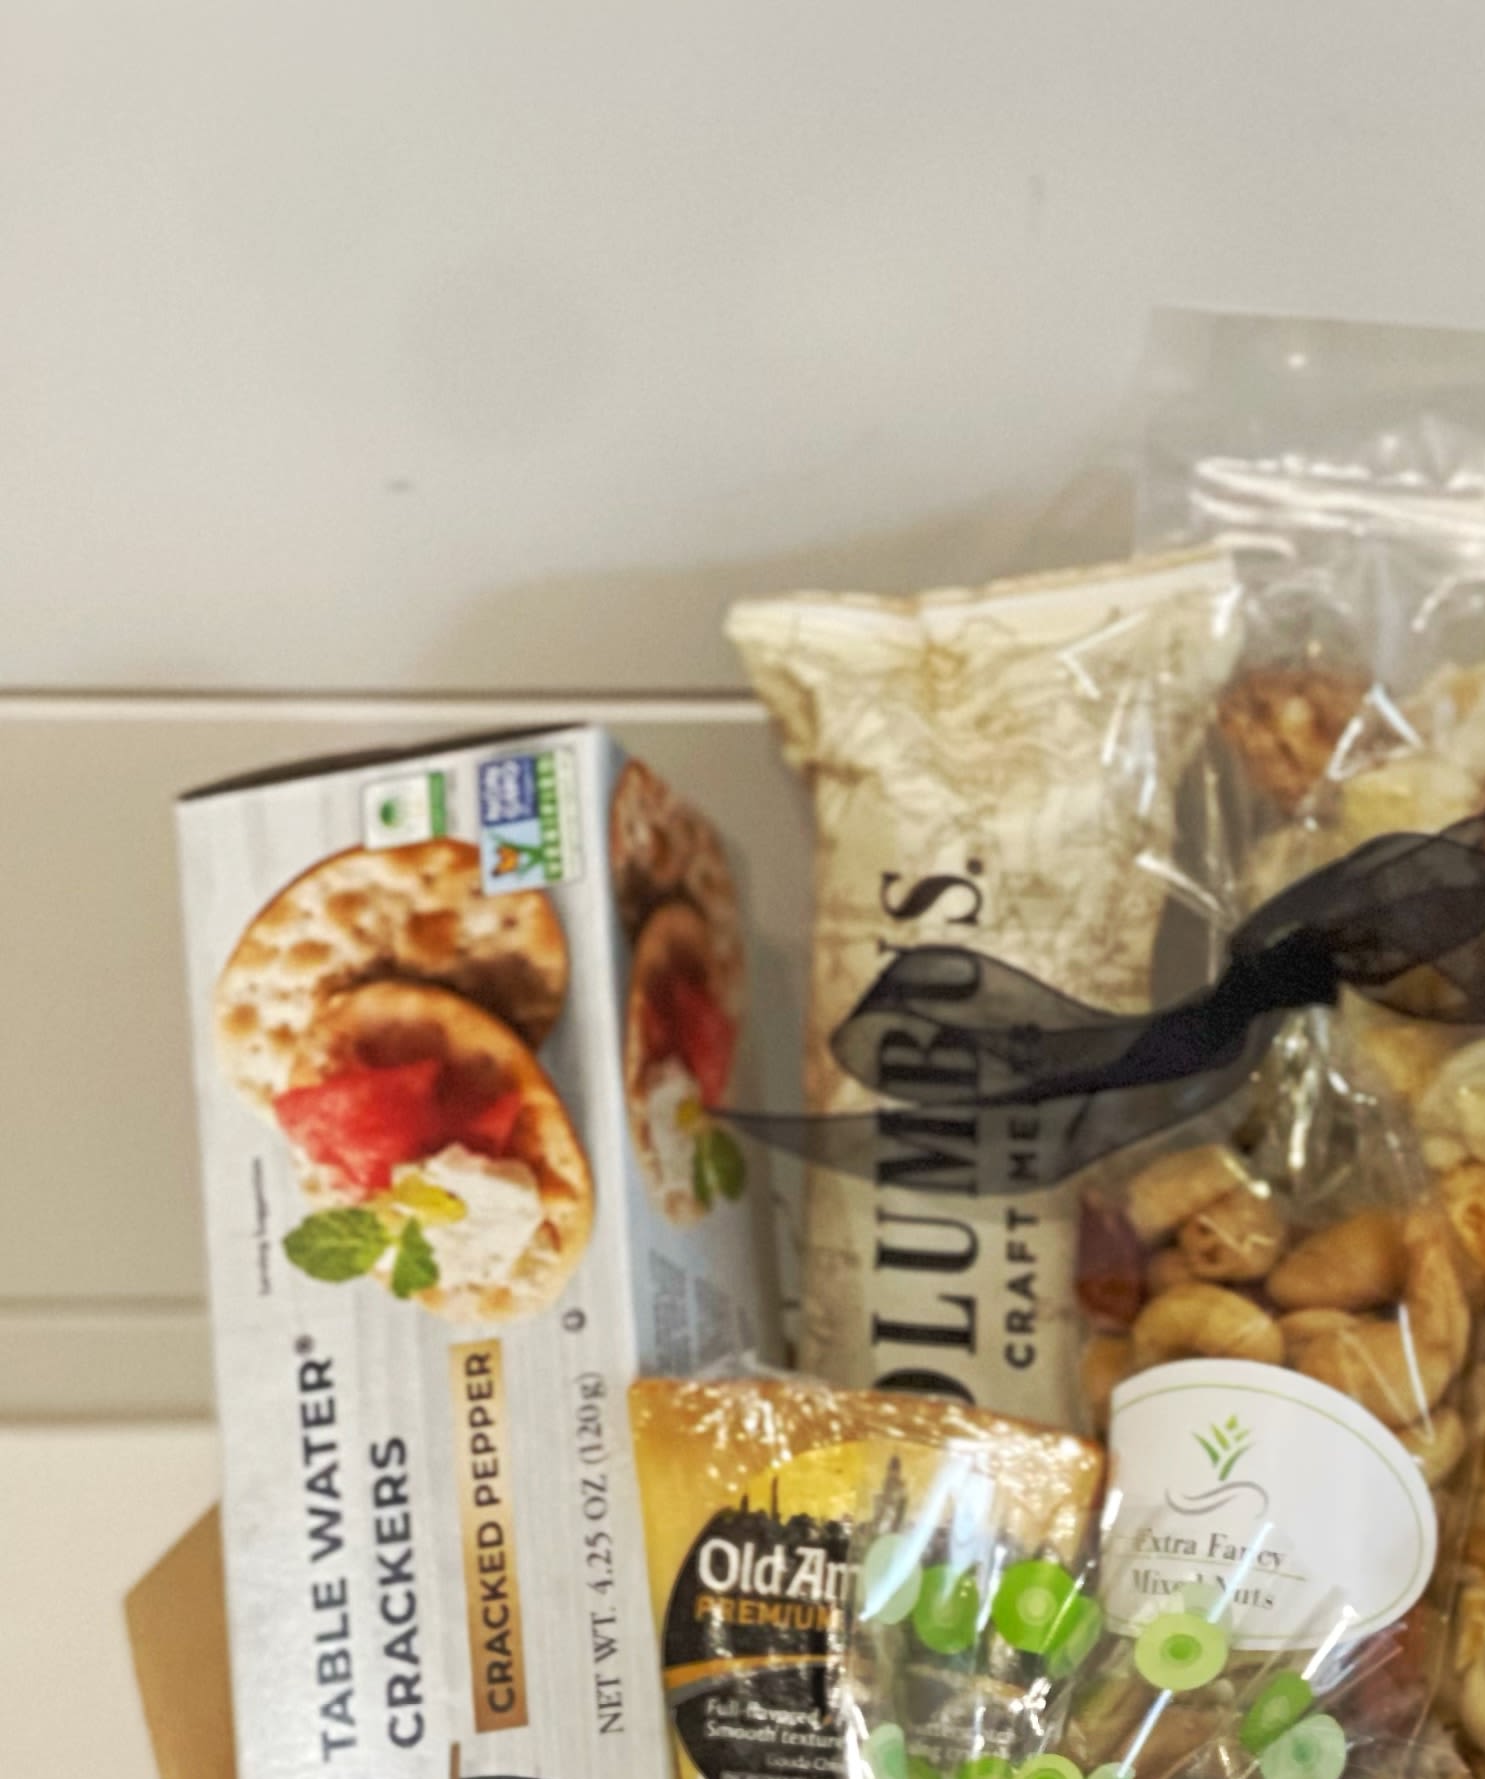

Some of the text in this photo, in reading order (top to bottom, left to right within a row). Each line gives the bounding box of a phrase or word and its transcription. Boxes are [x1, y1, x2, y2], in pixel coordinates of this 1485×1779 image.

[1005, 1210, 1040, 1369] CRAFT
[371, 1436, 425, 1749] CRACKERS
[464, 1351, 517, 1714] CRACKED PEPPER
[575, 1370, 626, 1736] NET WT. 4.25 OZ (120g)
[699, 1537, 787, 1595] Old
[311, 1578, 356, 1765] TABLE
